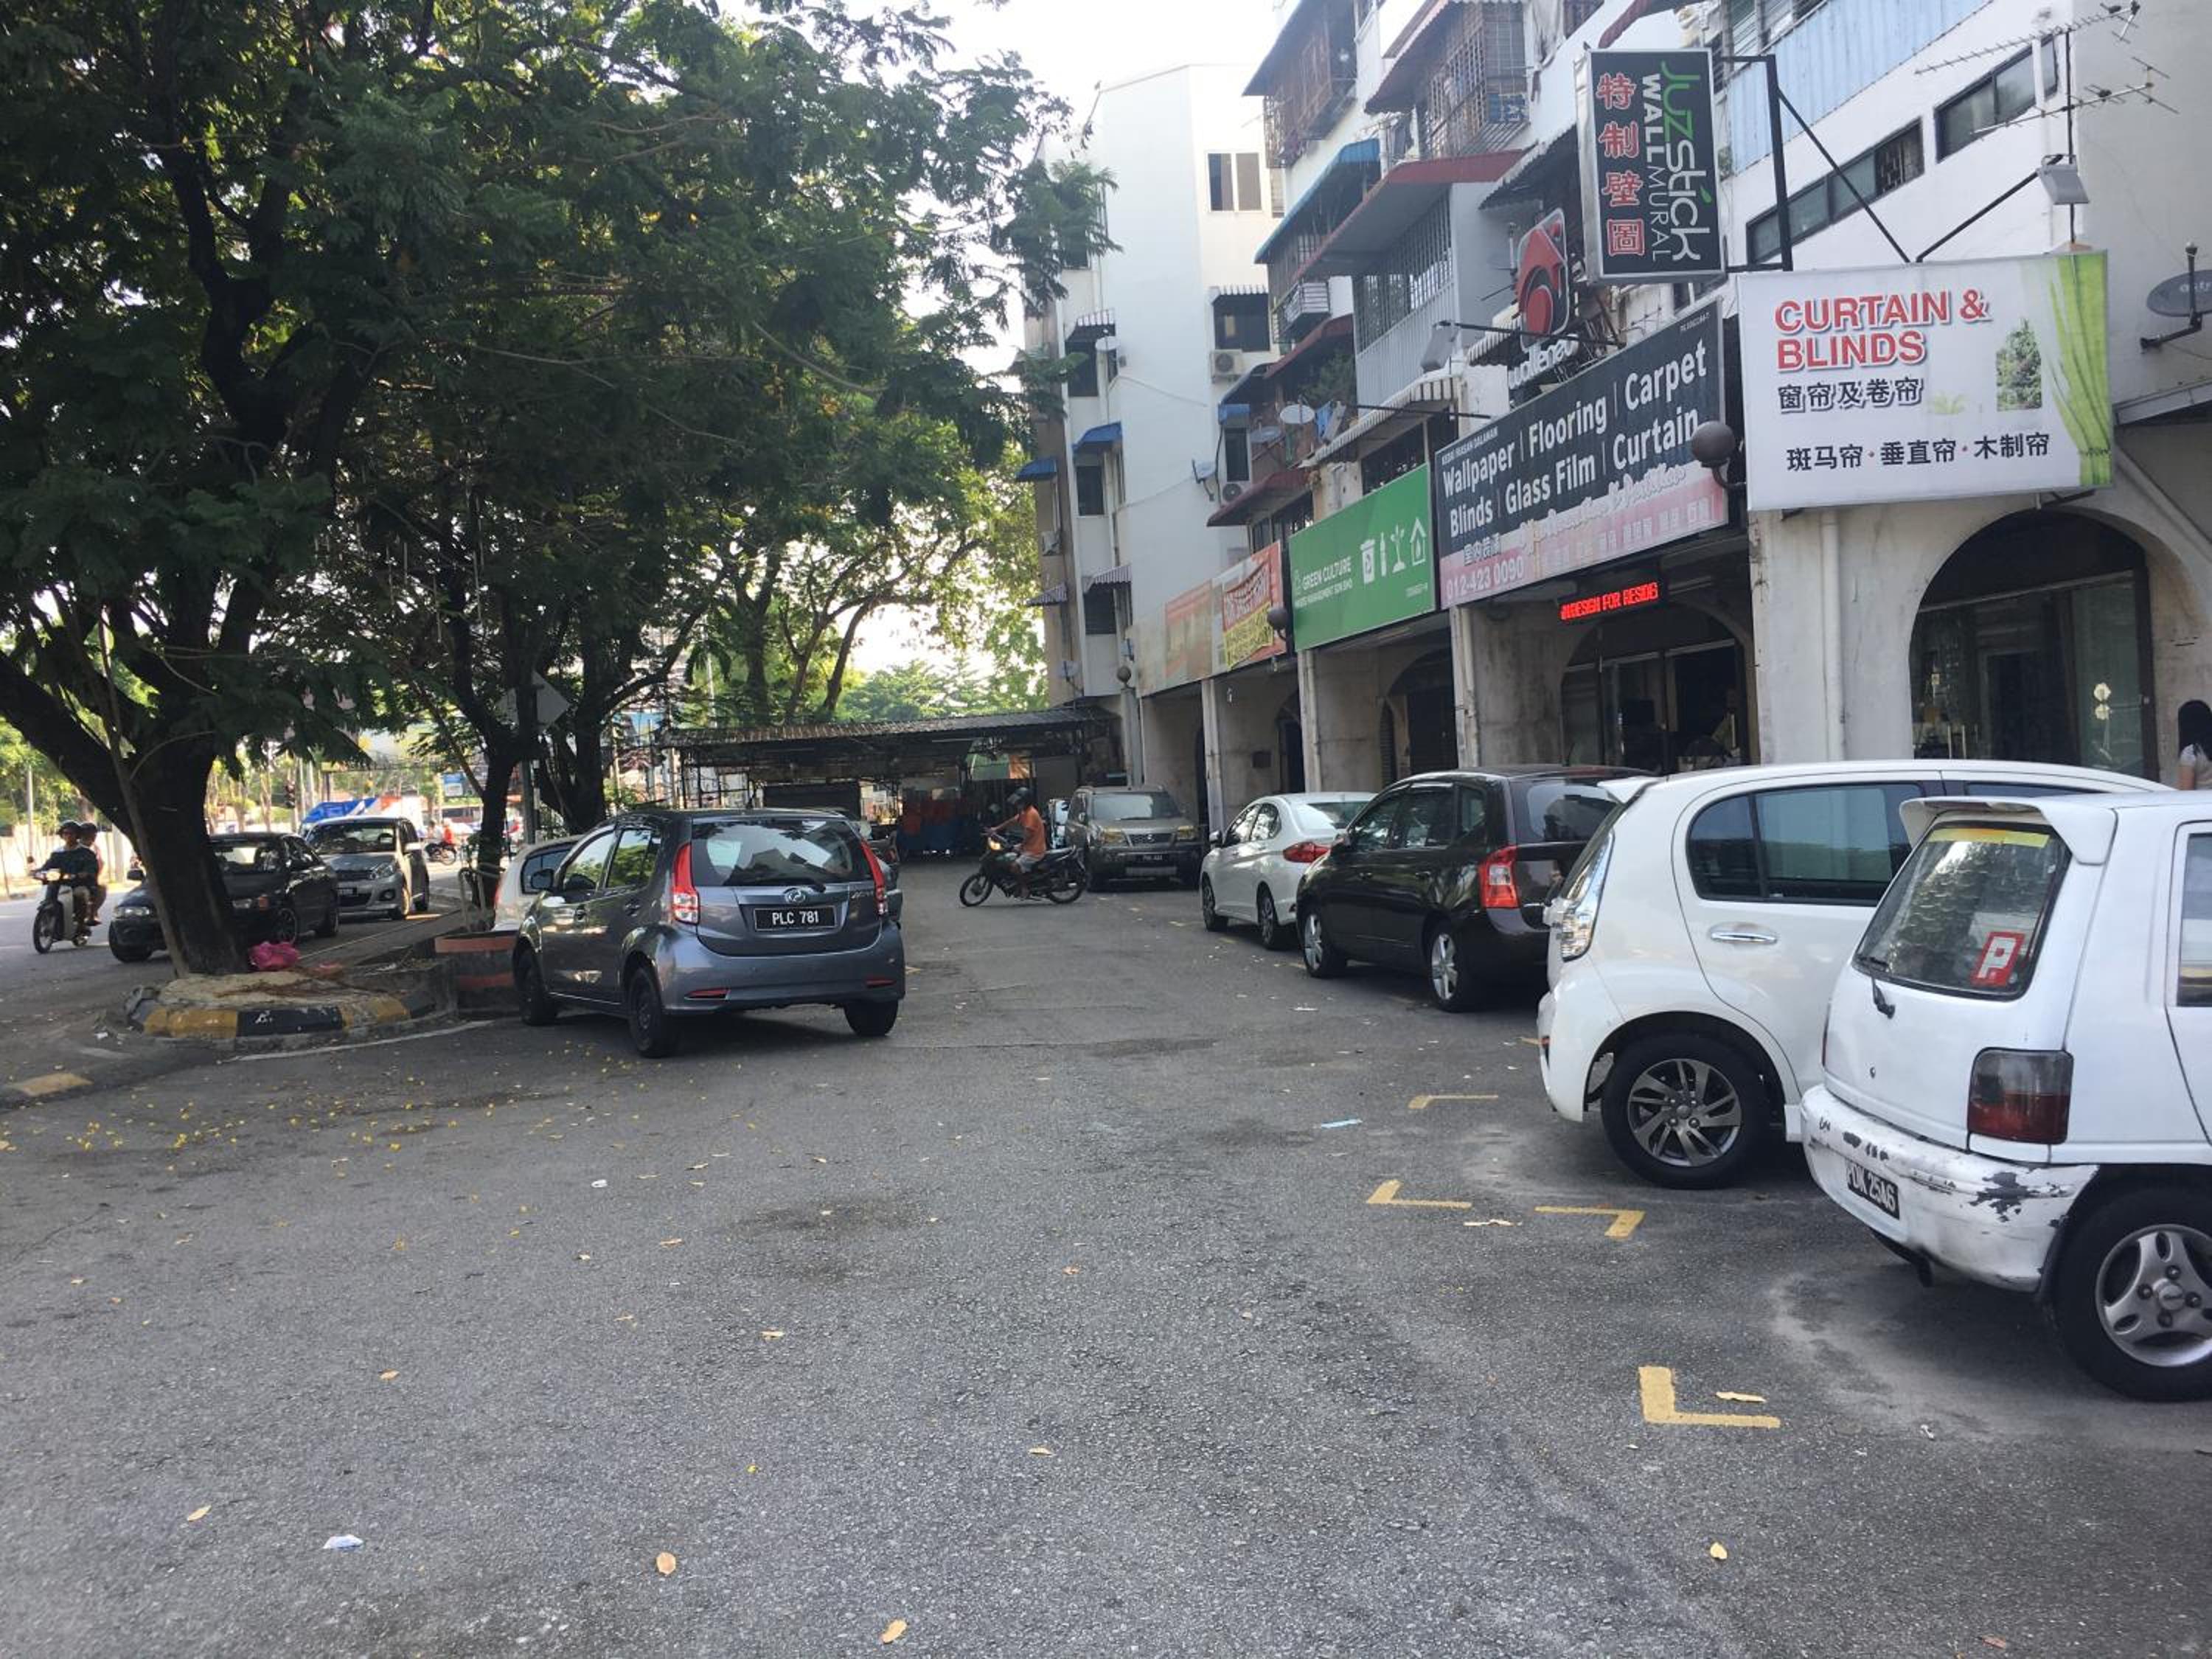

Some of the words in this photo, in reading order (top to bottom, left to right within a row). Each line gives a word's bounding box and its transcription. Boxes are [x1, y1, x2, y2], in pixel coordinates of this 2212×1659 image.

[1774, 291, 1950, 333] CURTAIN
[1959, 288, 1992, 321] &
[1777, 331, 1926, 372] BLINDS
[1778, 377, 1924, 414] 窗帘及卷帘
[1443, 441, 1514, 498] Wallpaper
[1528, 394, 1607, 457] Flooring
[1625, 339, 1707, 411] Carpet
[1450, 496, 1493, 538] Blinds
[1505, 470, 1551, 515] Glass
[1555, 453, 1596, 495] Film
[1613, 407, 1699, 470] Curtain
[1302, 569, 1322, 591] GREEN
[1322, 556, 1352, 582] CULTURE
[1494, 556, 1524, 586] 0090
[1602, 591, 1621, 611] FOR
[772, 911, 795, 925] PLC
[799, 911, 819, 924] 781
[1976, 936, 2017, 979] P
